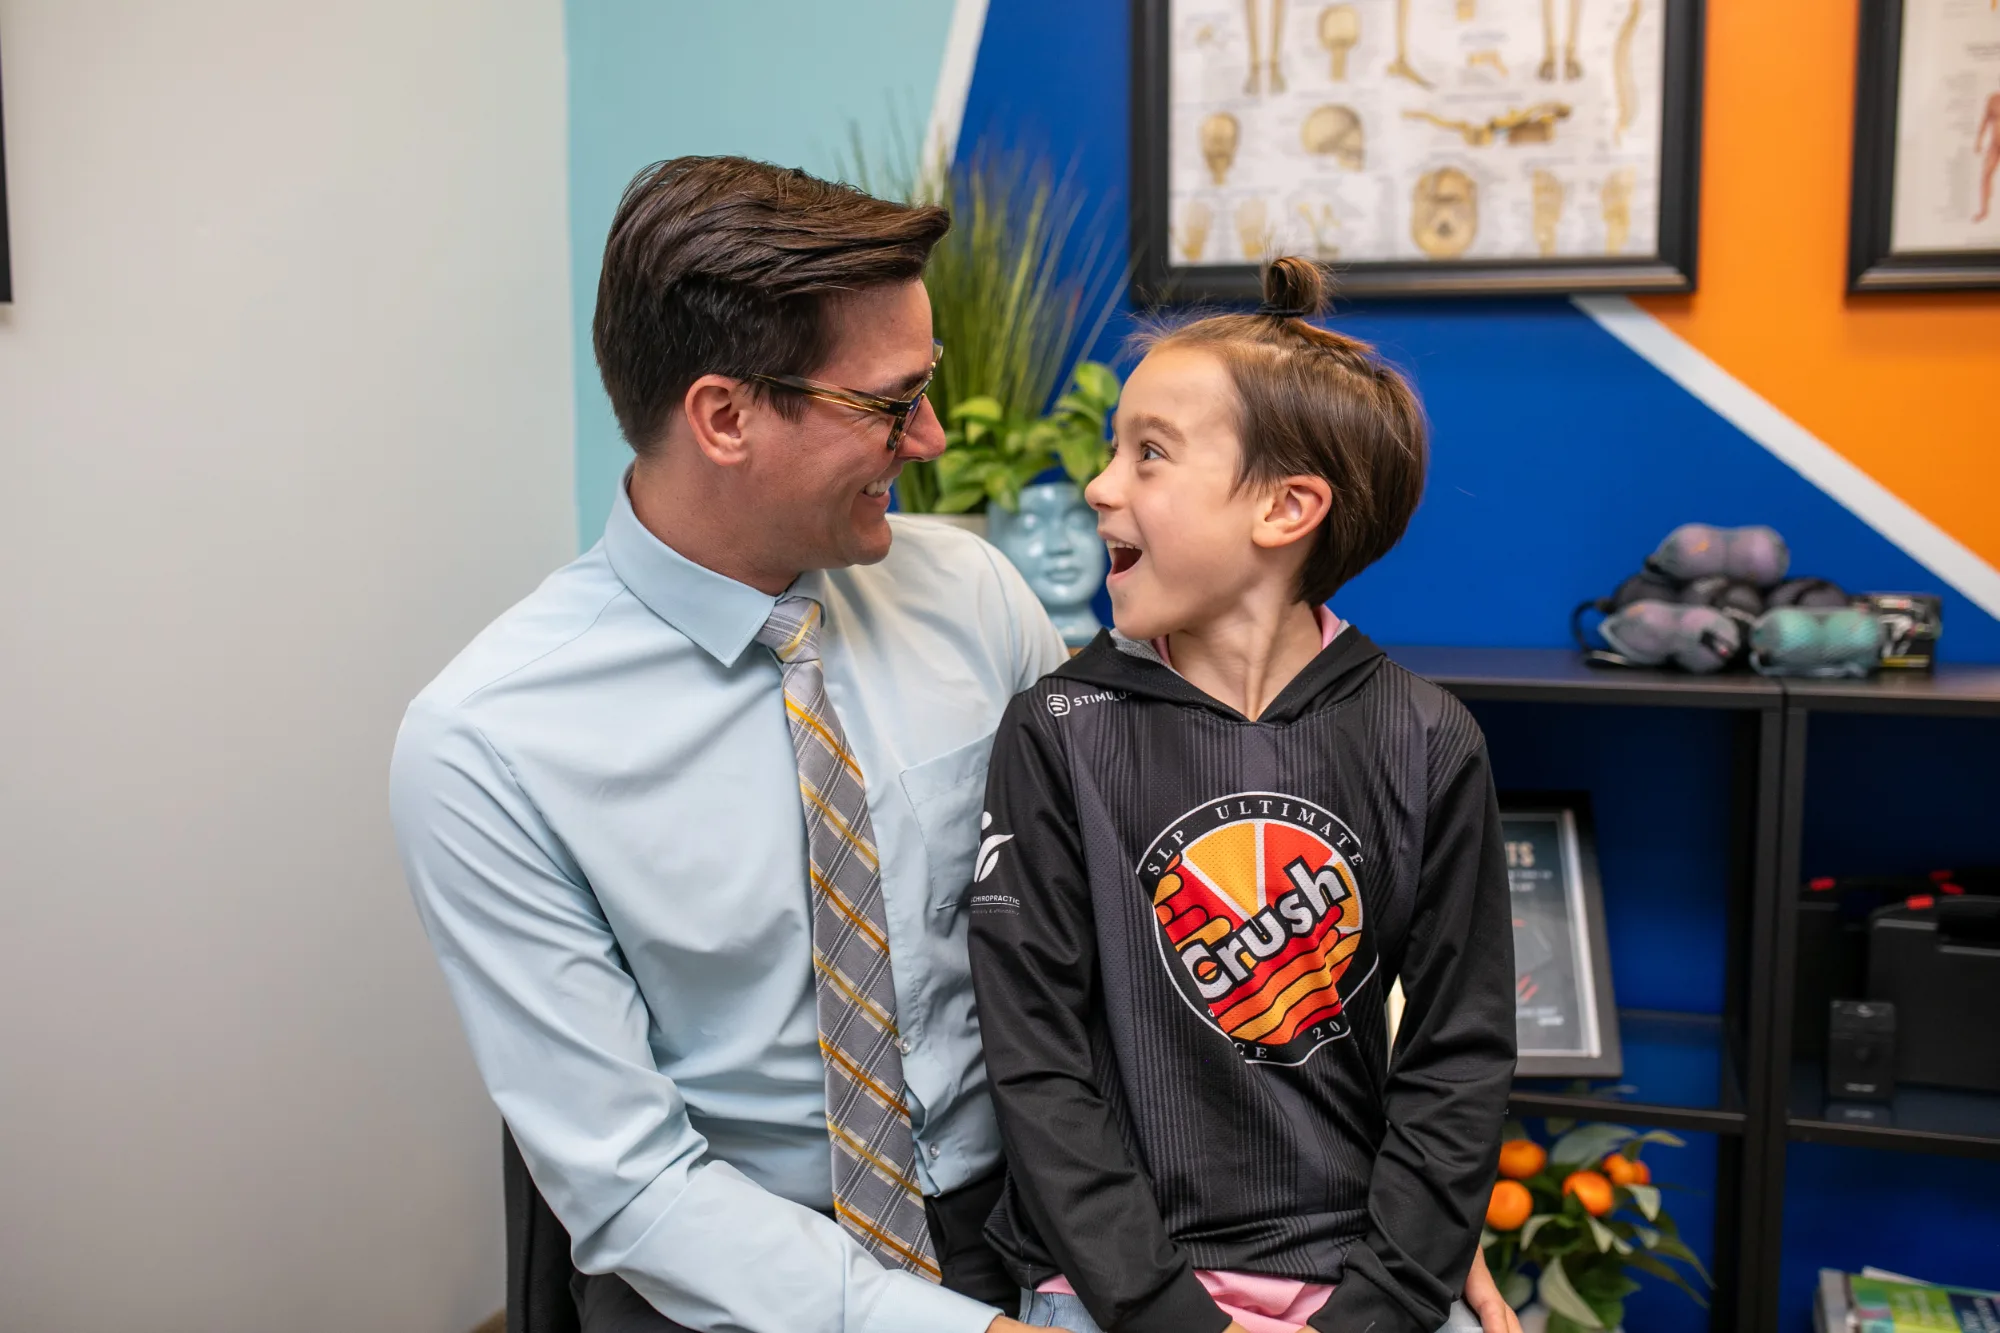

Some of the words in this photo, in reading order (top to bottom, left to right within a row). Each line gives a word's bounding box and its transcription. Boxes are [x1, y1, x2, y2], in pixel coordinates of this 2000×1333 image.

[1073, 691, 1132, 706] STIMULU
[1148, 830, 1185, 876] SLP
[1215, 800, 1365, 866] ULTIMATE
[1180, 857, 1350, 999] Crush
[1312, 1021, 1341, 1040] 20
